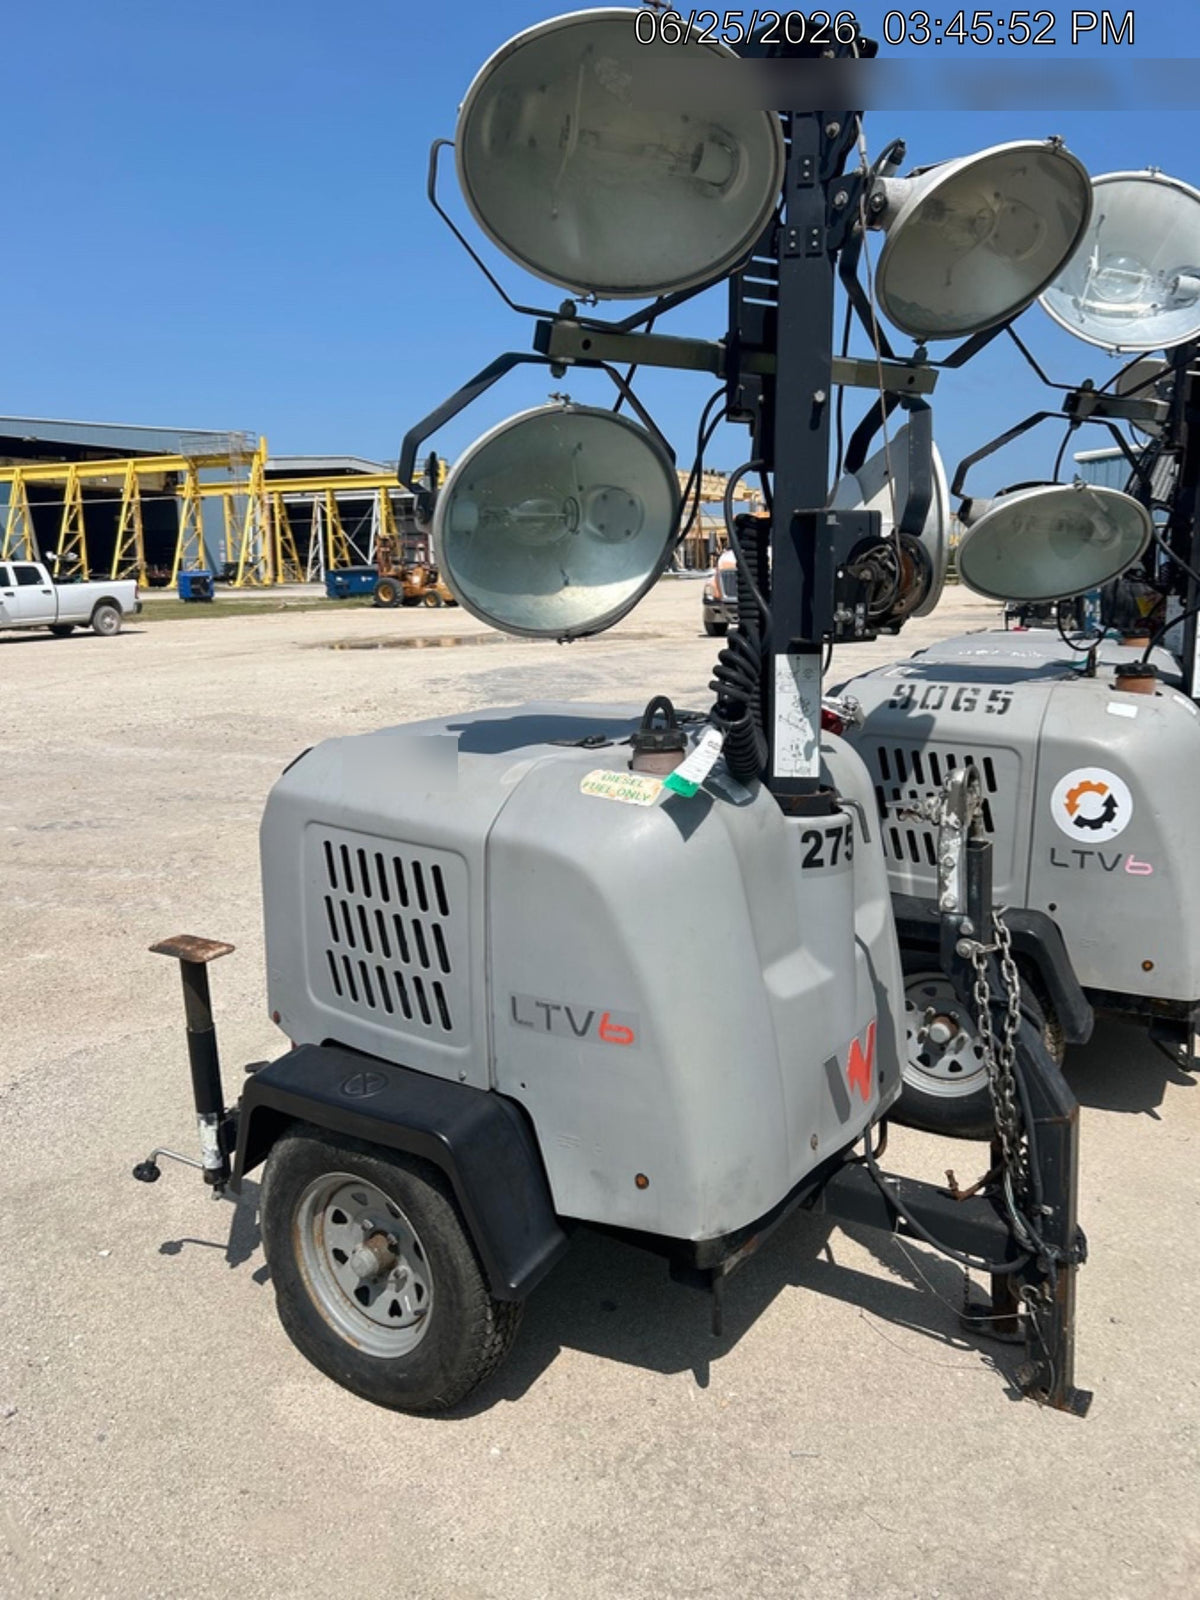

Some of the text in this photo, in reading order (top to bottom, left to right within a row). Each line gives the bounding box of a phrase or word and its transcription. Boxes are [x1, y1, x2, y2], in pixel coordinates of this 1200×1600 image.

[582, 781, 652, 802] FUEL ONLY
[601, 773, 644, 788] DIESEL
[1050, 847, 1153, 876] LTV6
[511, 995, 635, 1046] LTV6
